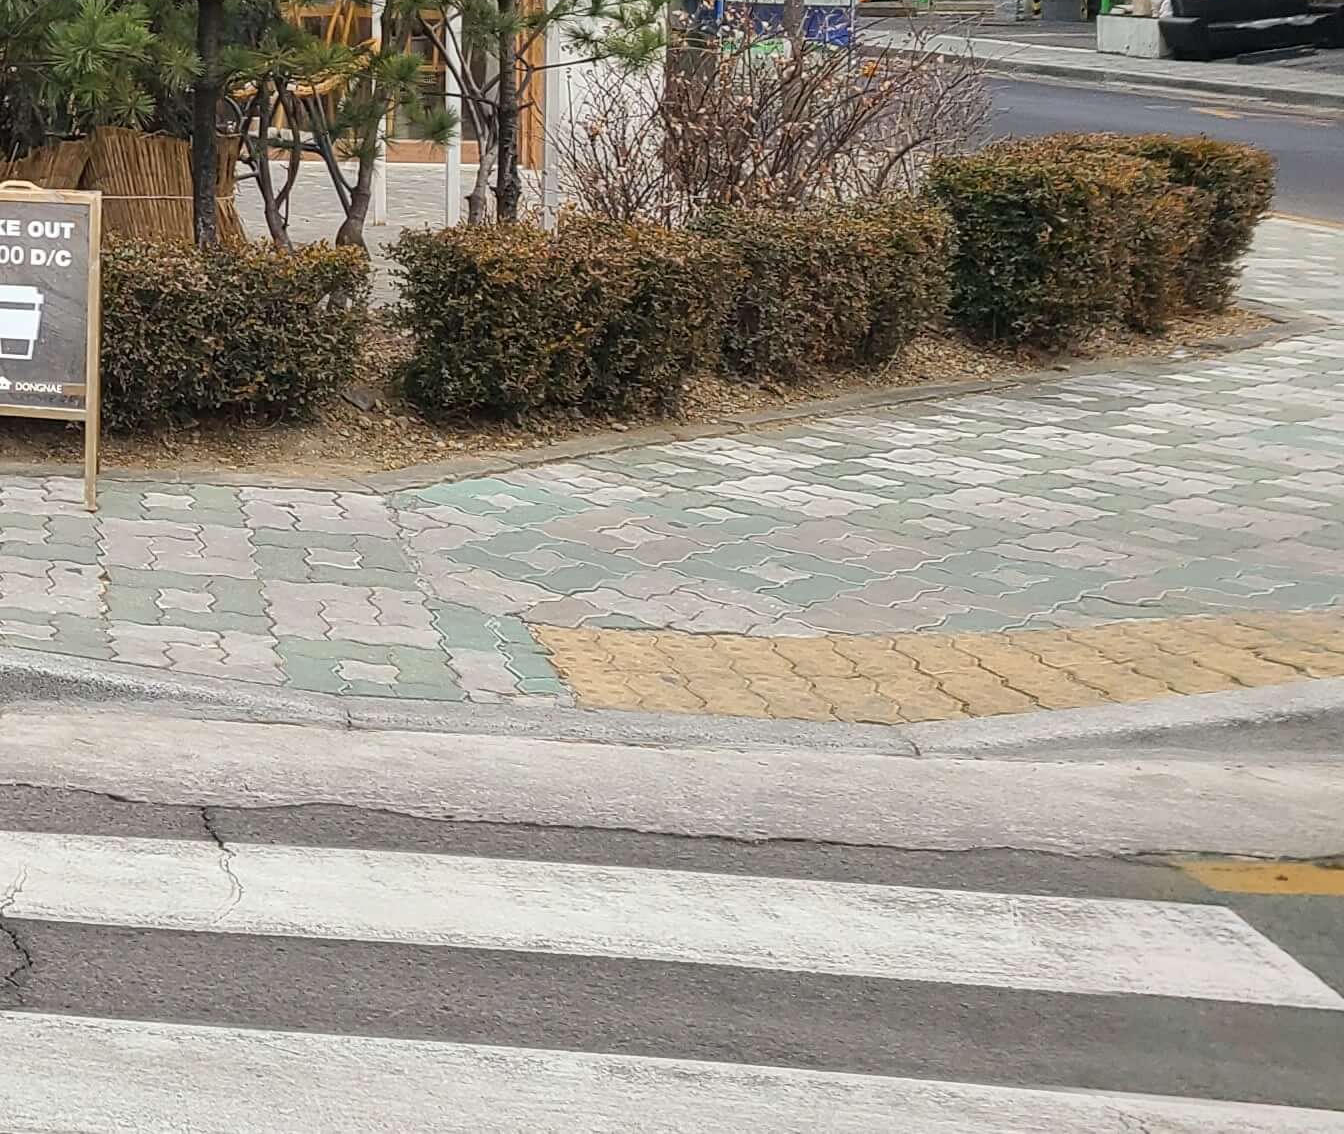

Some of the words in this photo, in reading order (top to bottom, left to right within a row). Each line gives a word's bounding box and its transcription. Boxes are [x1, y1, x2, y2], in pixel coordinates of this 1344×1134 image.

[27, 221, 76, 239] OUT
[30, 248, 72, 267] D/C
[15, 381, 63, 394] DONGNAE
